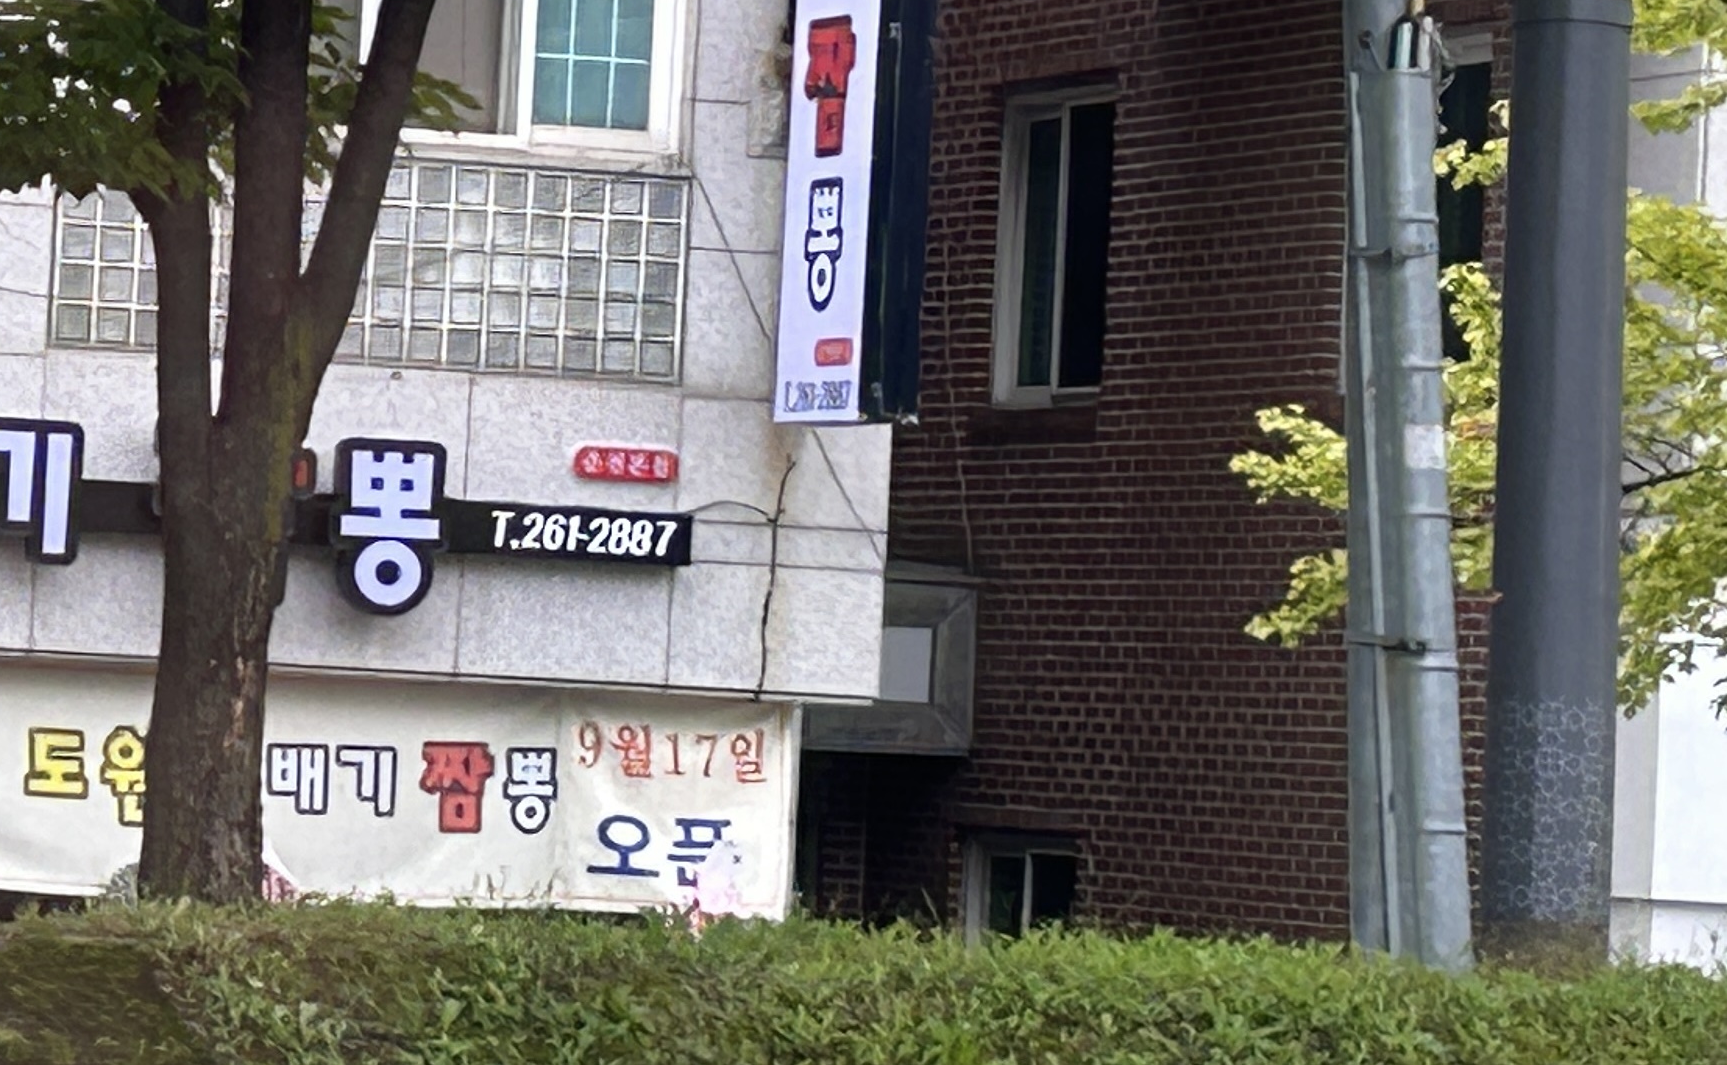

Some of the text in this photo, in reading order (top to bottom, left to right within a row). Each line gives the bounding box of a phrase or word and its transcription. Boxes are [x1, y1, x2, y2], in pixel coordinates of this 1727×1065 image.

[804, 14, 857, 312] 짬뽕
[491, 510, 678, 557] T.261-2887
[24, 726, 559, 834] 도원 배기 짬뽕
